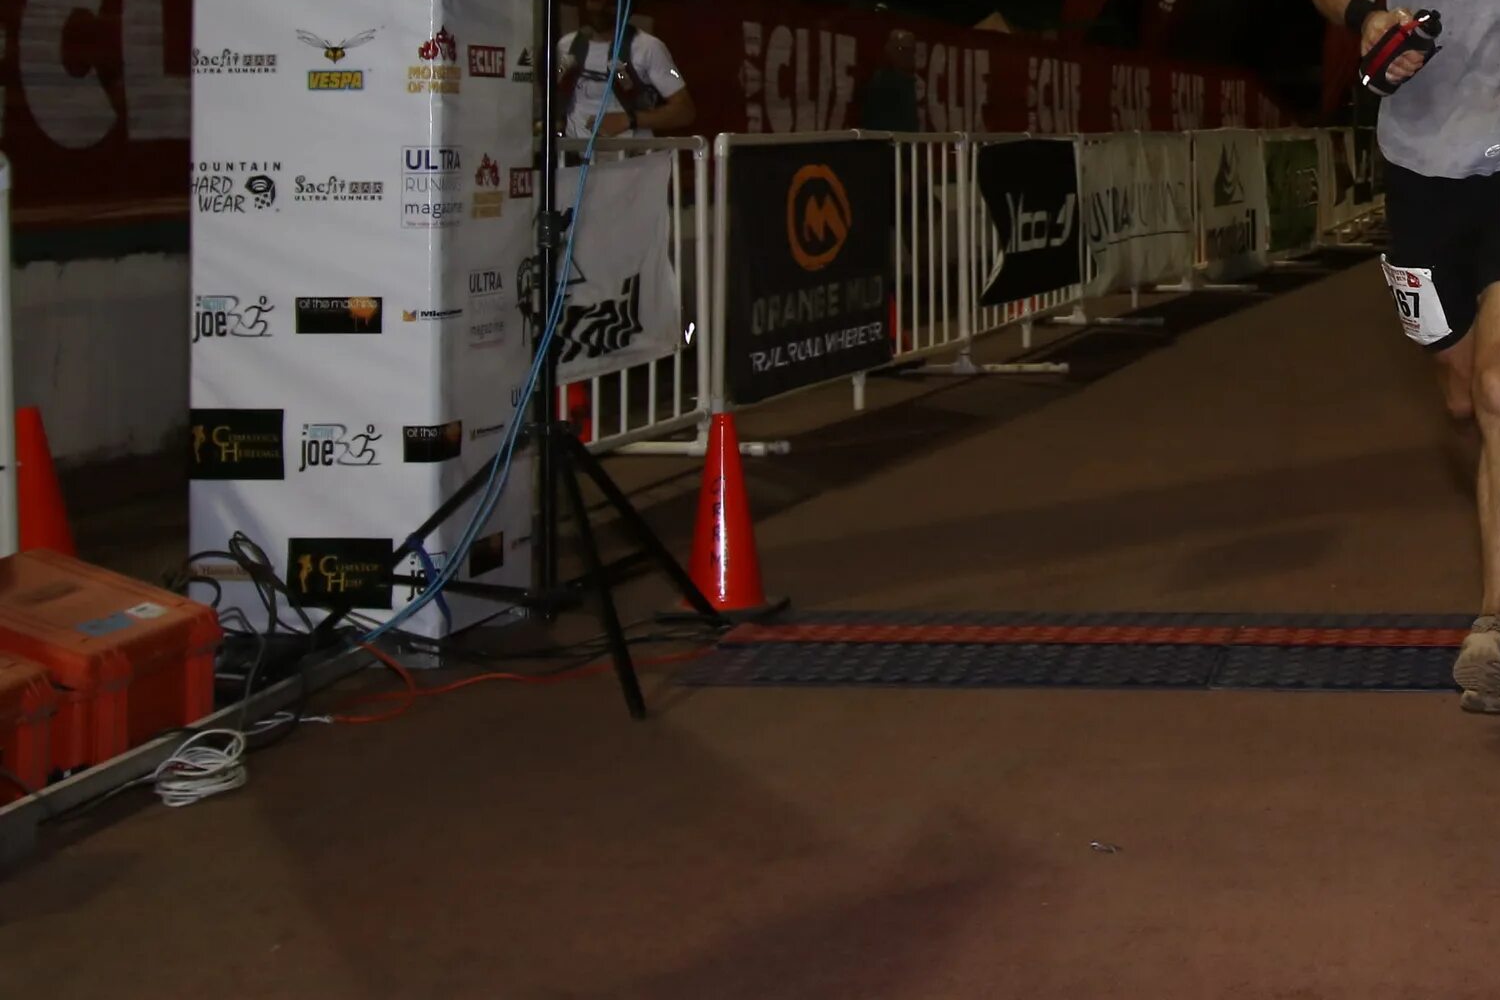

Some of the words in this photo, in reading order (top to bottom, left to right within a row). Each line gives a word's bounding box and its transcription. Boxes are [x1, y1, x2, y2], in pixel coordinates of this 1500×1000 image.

[476, 50, 503, 73] CLIF
[308, 71, 363, 90] VESPA
[764, 25, 857, 133] CLIF
[929, 44, 989, 131] CLIF
[406, 150, 461, 170] ULTRA
[198, 195, 245, 212] WEAR
[405, 201, 463, 218] magazine
[469, 272, 503, 294] ULTRA
